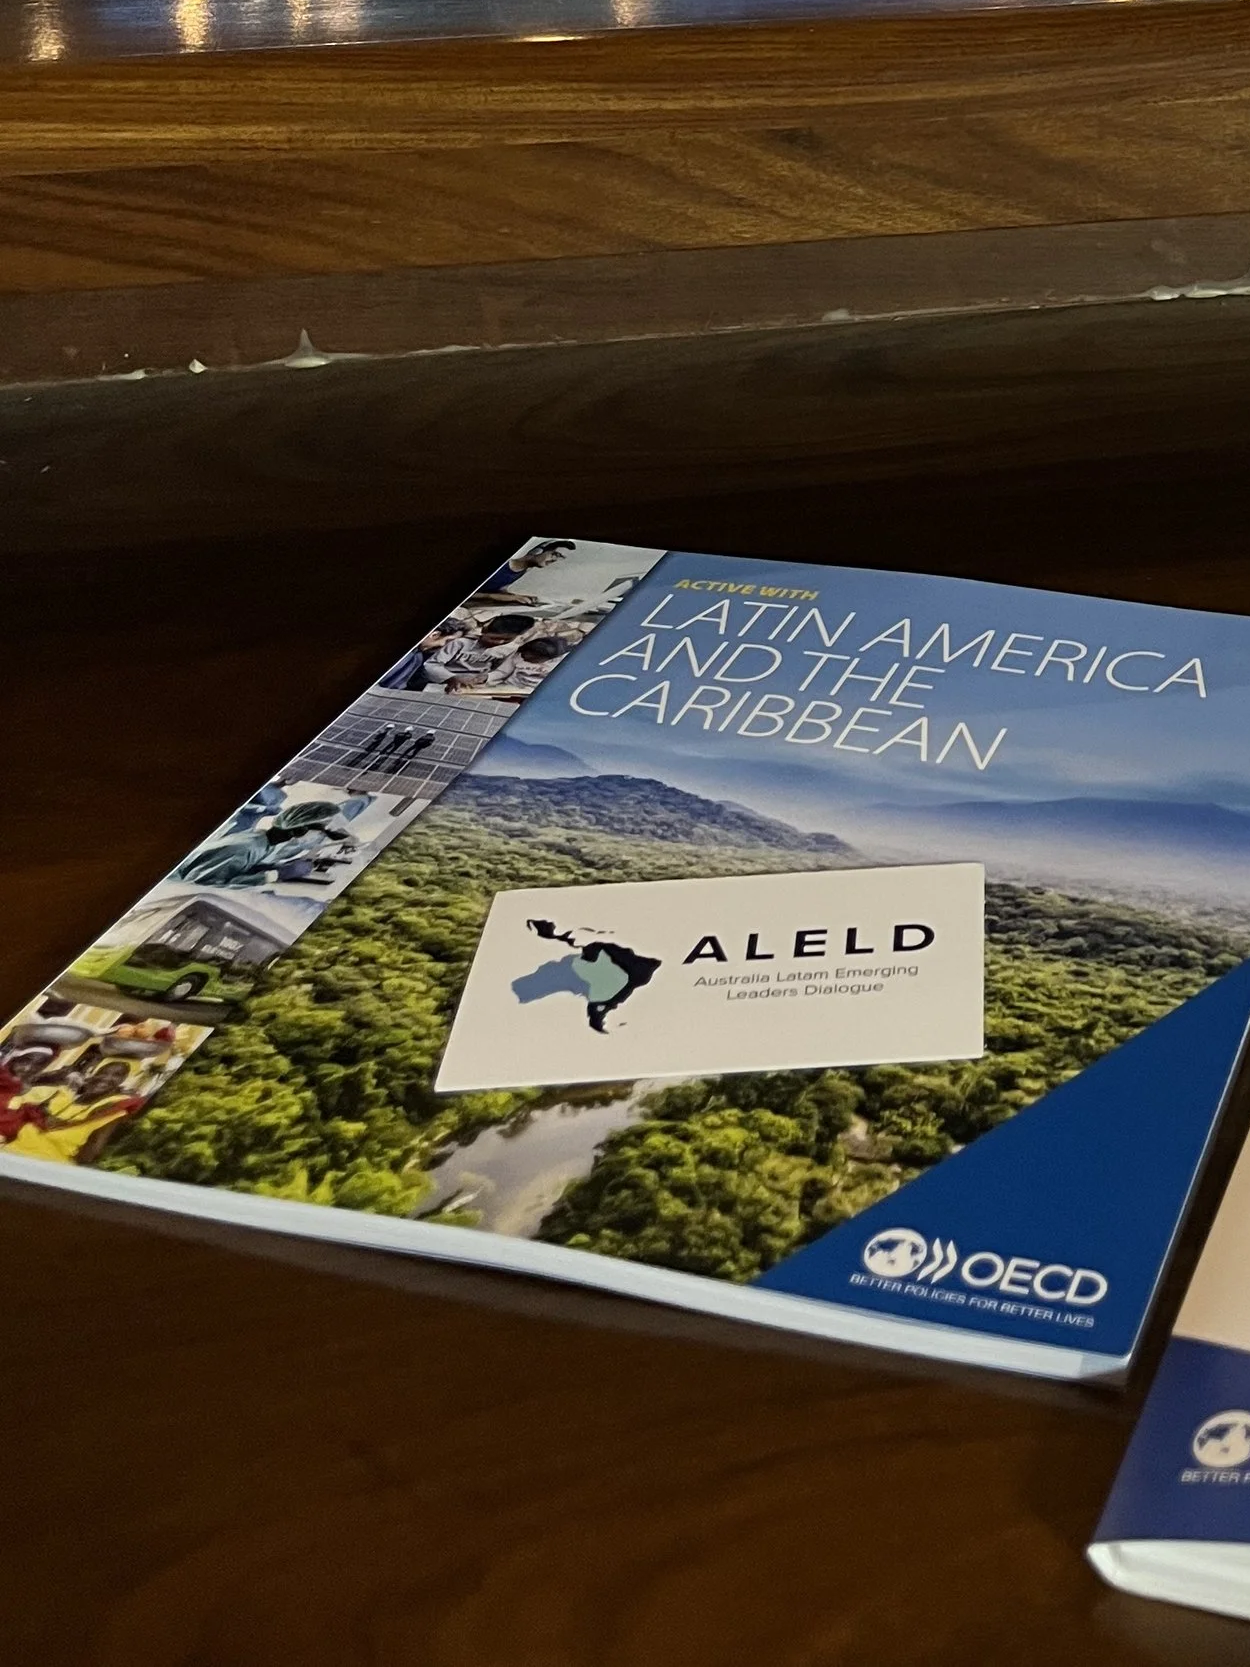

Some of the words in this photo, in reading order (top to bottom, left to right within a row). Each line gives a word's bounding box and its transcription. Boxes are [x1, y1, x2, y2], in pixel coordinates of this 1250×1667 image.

[673, 578, 757, 596] ACTIVE
[759, 585, 821, 601] WITH
[640, 593, 857, 648] LATIN
[858, 617, 1208, 698] AMERICA
[598, 633, 783, 684] AND
[798, 650, 947, 710] THE
[568, 673, 1008, 771] CARIBBEAN
[681, 923, 936, 965] ALELD
[694, 972, 771, 988] Australia
[776, 969, 830, 983] Latam
[835, 964, 920, 980] Emerging
[726, 986, 798, 1002] Leaders
[804, 981, 886, 998] Dialogue
[849, 1273, 904, 1292] BETTER
[905, 1284, 966, 1305] POLICIES
[969, 1296, 999, 1311] FOR
[1000, 1302, 1053, 1321] BETTER
[1055, 1312, 1095, 1329] LIVES
[961, 1251, 1109, 1305] OECD
[1180, 1470, 1241, 1484] BETTER
